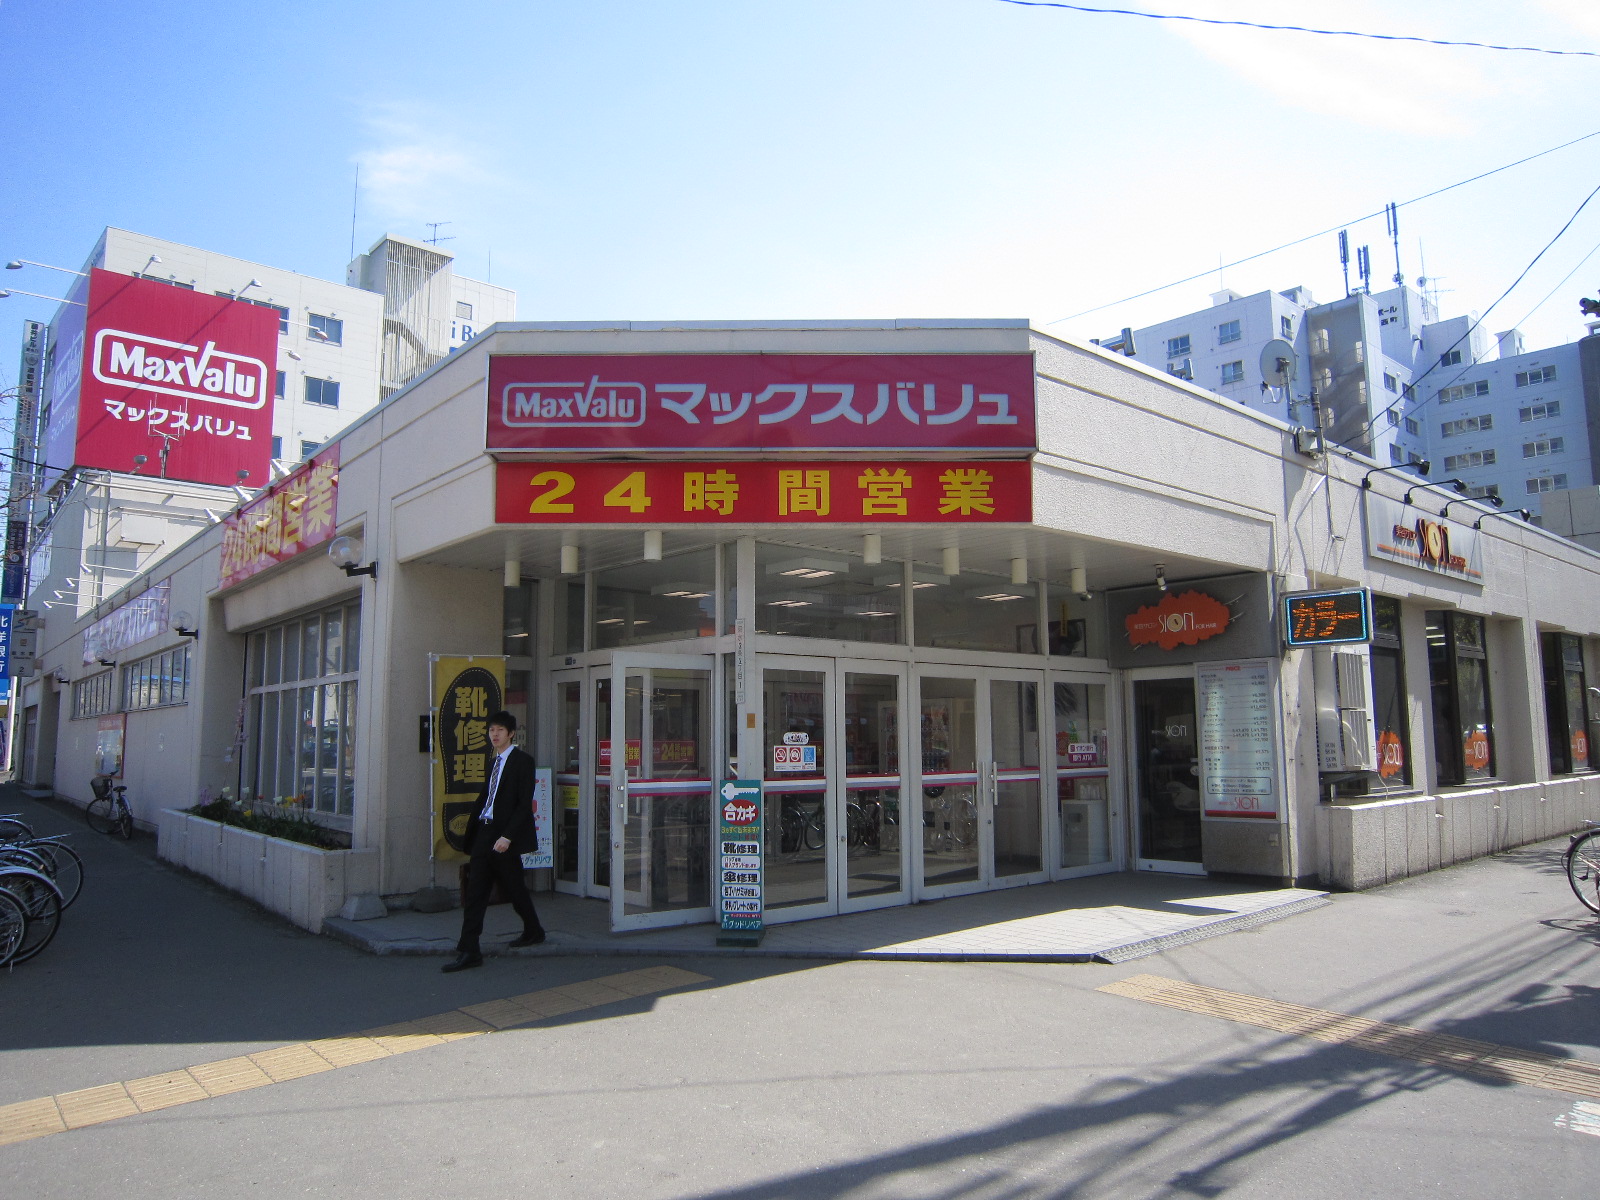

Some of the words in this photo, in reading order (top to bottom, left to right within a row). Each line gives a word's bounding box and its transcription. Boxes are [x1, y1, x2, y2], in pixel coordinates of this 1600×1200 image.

[110, 341, 255, 398] MaxValu
[514, 375, 635, 418] MaxValu
[655, 382, 1017, 425] マックスバリュ
[104, 399, 251, 441] マックスバリュ
[529, 468, 995, 516] 24時間営業
[222, 458, 335, 579] 24時間営業
[1292, 600, 1360, 638] カラー
[454, 687, 487, 783] 靴修理
[724, 802, 756, 821] 合カギ
[524, 855, 551, 866] グッドリペア
[723, 842, 757, 854] 靴修理
[724, 871, 757, 882] 傘修理
[729, 920, 761, 929] グッドリペア
